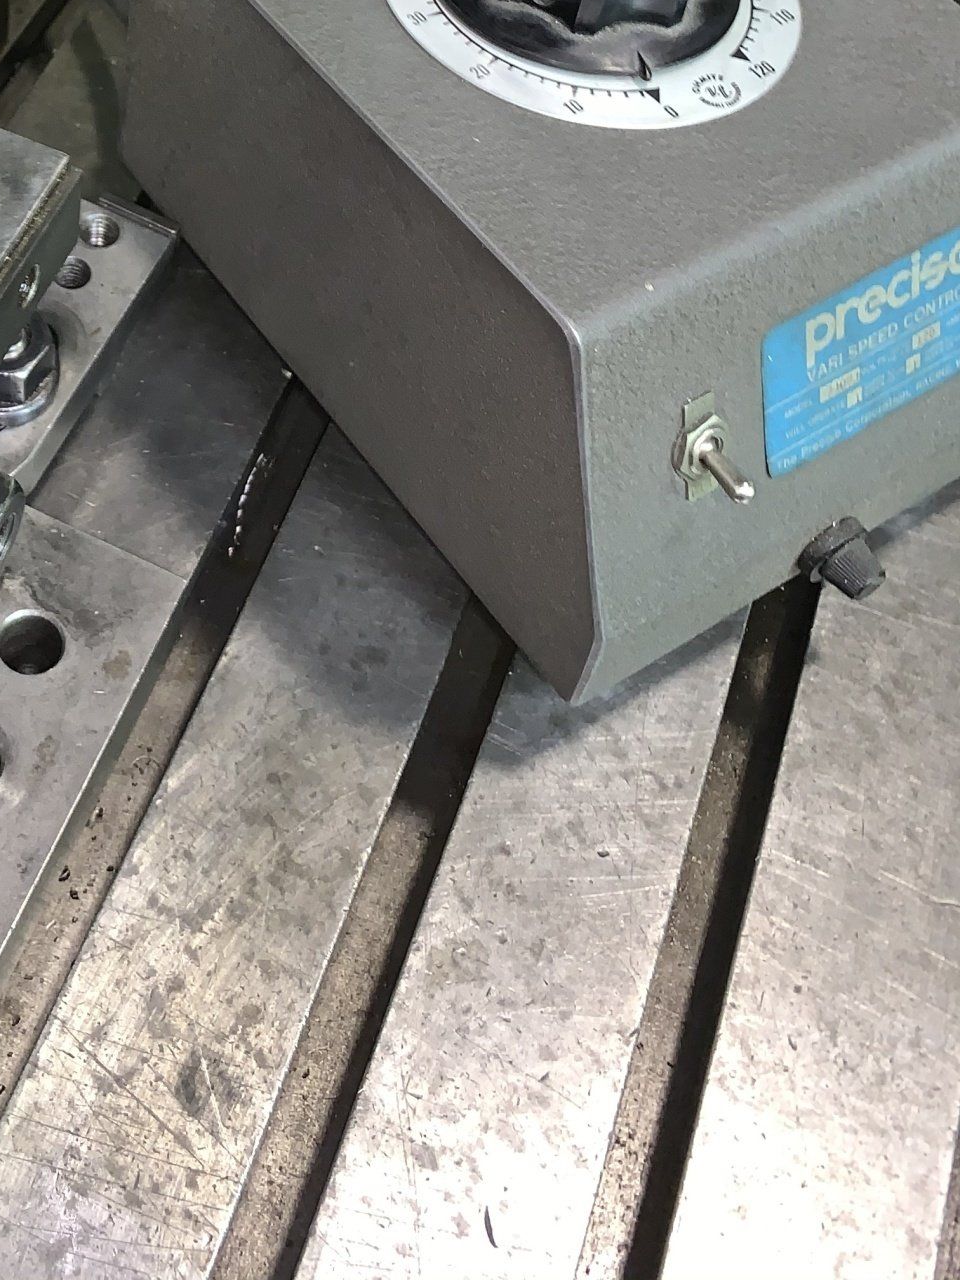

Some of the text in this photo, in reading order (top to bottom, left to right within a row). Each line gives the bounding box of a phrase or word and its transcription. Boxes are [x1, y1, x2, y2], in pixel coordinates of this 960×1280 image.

[407, 11, 427, 26] 30
[770, 8, 795, 25] 110
[470, 63, 490, 79] 20
[748, 60, 776, 78] 120
[563, 99, 584, 114] 10
[664, 105, 680, 118] 0
[848, 322, 898, 356] SPEED
